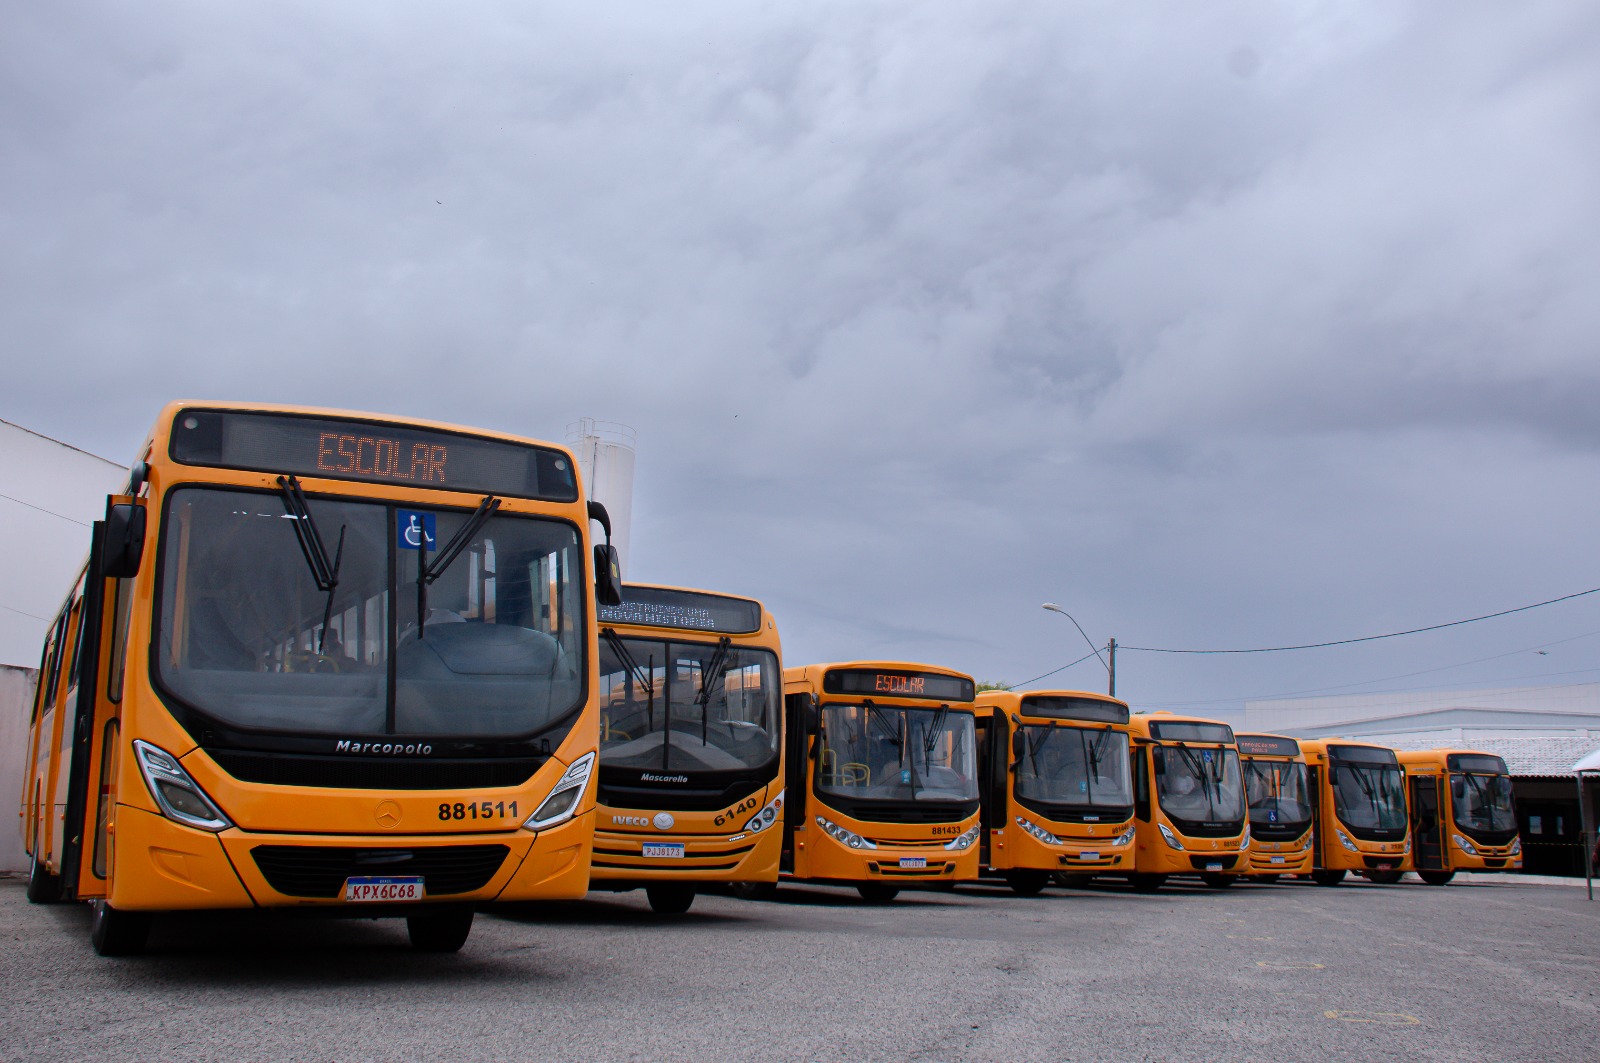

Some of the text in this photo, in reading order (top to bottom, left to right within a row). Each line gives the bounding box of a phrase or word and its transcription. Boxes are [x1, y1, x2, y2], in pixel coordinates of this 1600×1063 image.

[317, 432, 447, 482] ESCOLAR
[601, 609, 641, 621] NOVA
[875, 674, 925, 694] ESCOLAR
[336, 740, 432, 755] Marcopolo
[641, 773, 688, 783] Mascarello
[438, 800, 518, 821] 881511
[713, 797, 757, 827] 6140
[612, 815, 649, 827] IVECO
[931, 826, 961, 835] 881433
[353, 884, 415, 899] KPX6C68
